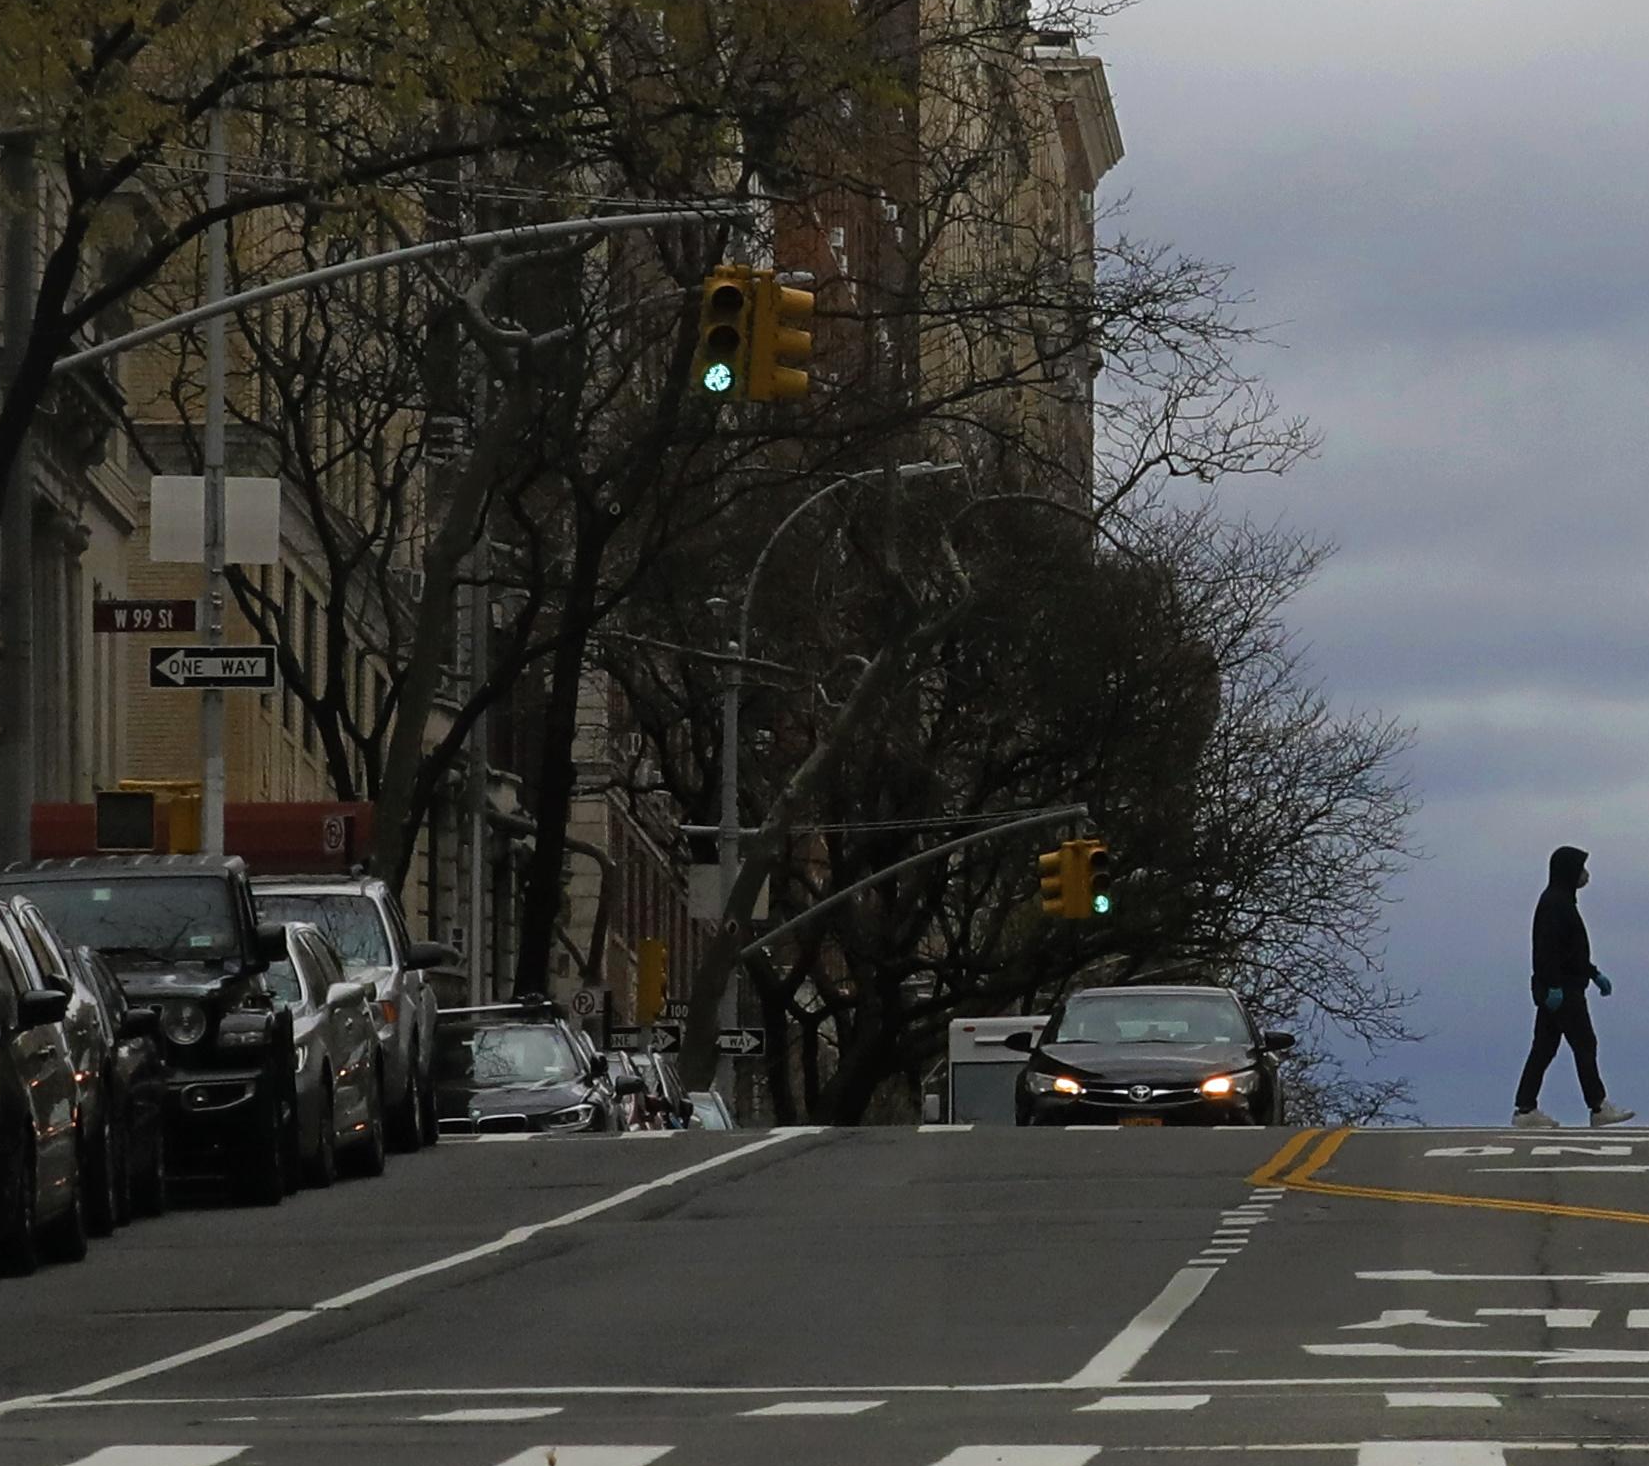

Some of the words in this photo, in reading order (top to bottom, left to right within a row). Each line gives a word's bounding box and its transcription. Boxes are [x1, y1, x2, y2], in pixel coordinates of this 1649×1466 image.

[114, 609, 128, 629] W
[133, 608, 152, 629] 99
[158, 609, 174, 629] St
[169, 659, 203, 675] ONE
[221, 659, 259, 675] WAY
[670, 1004, 689, 1018] 100
[730, 1036, 752, 1048] WAY
